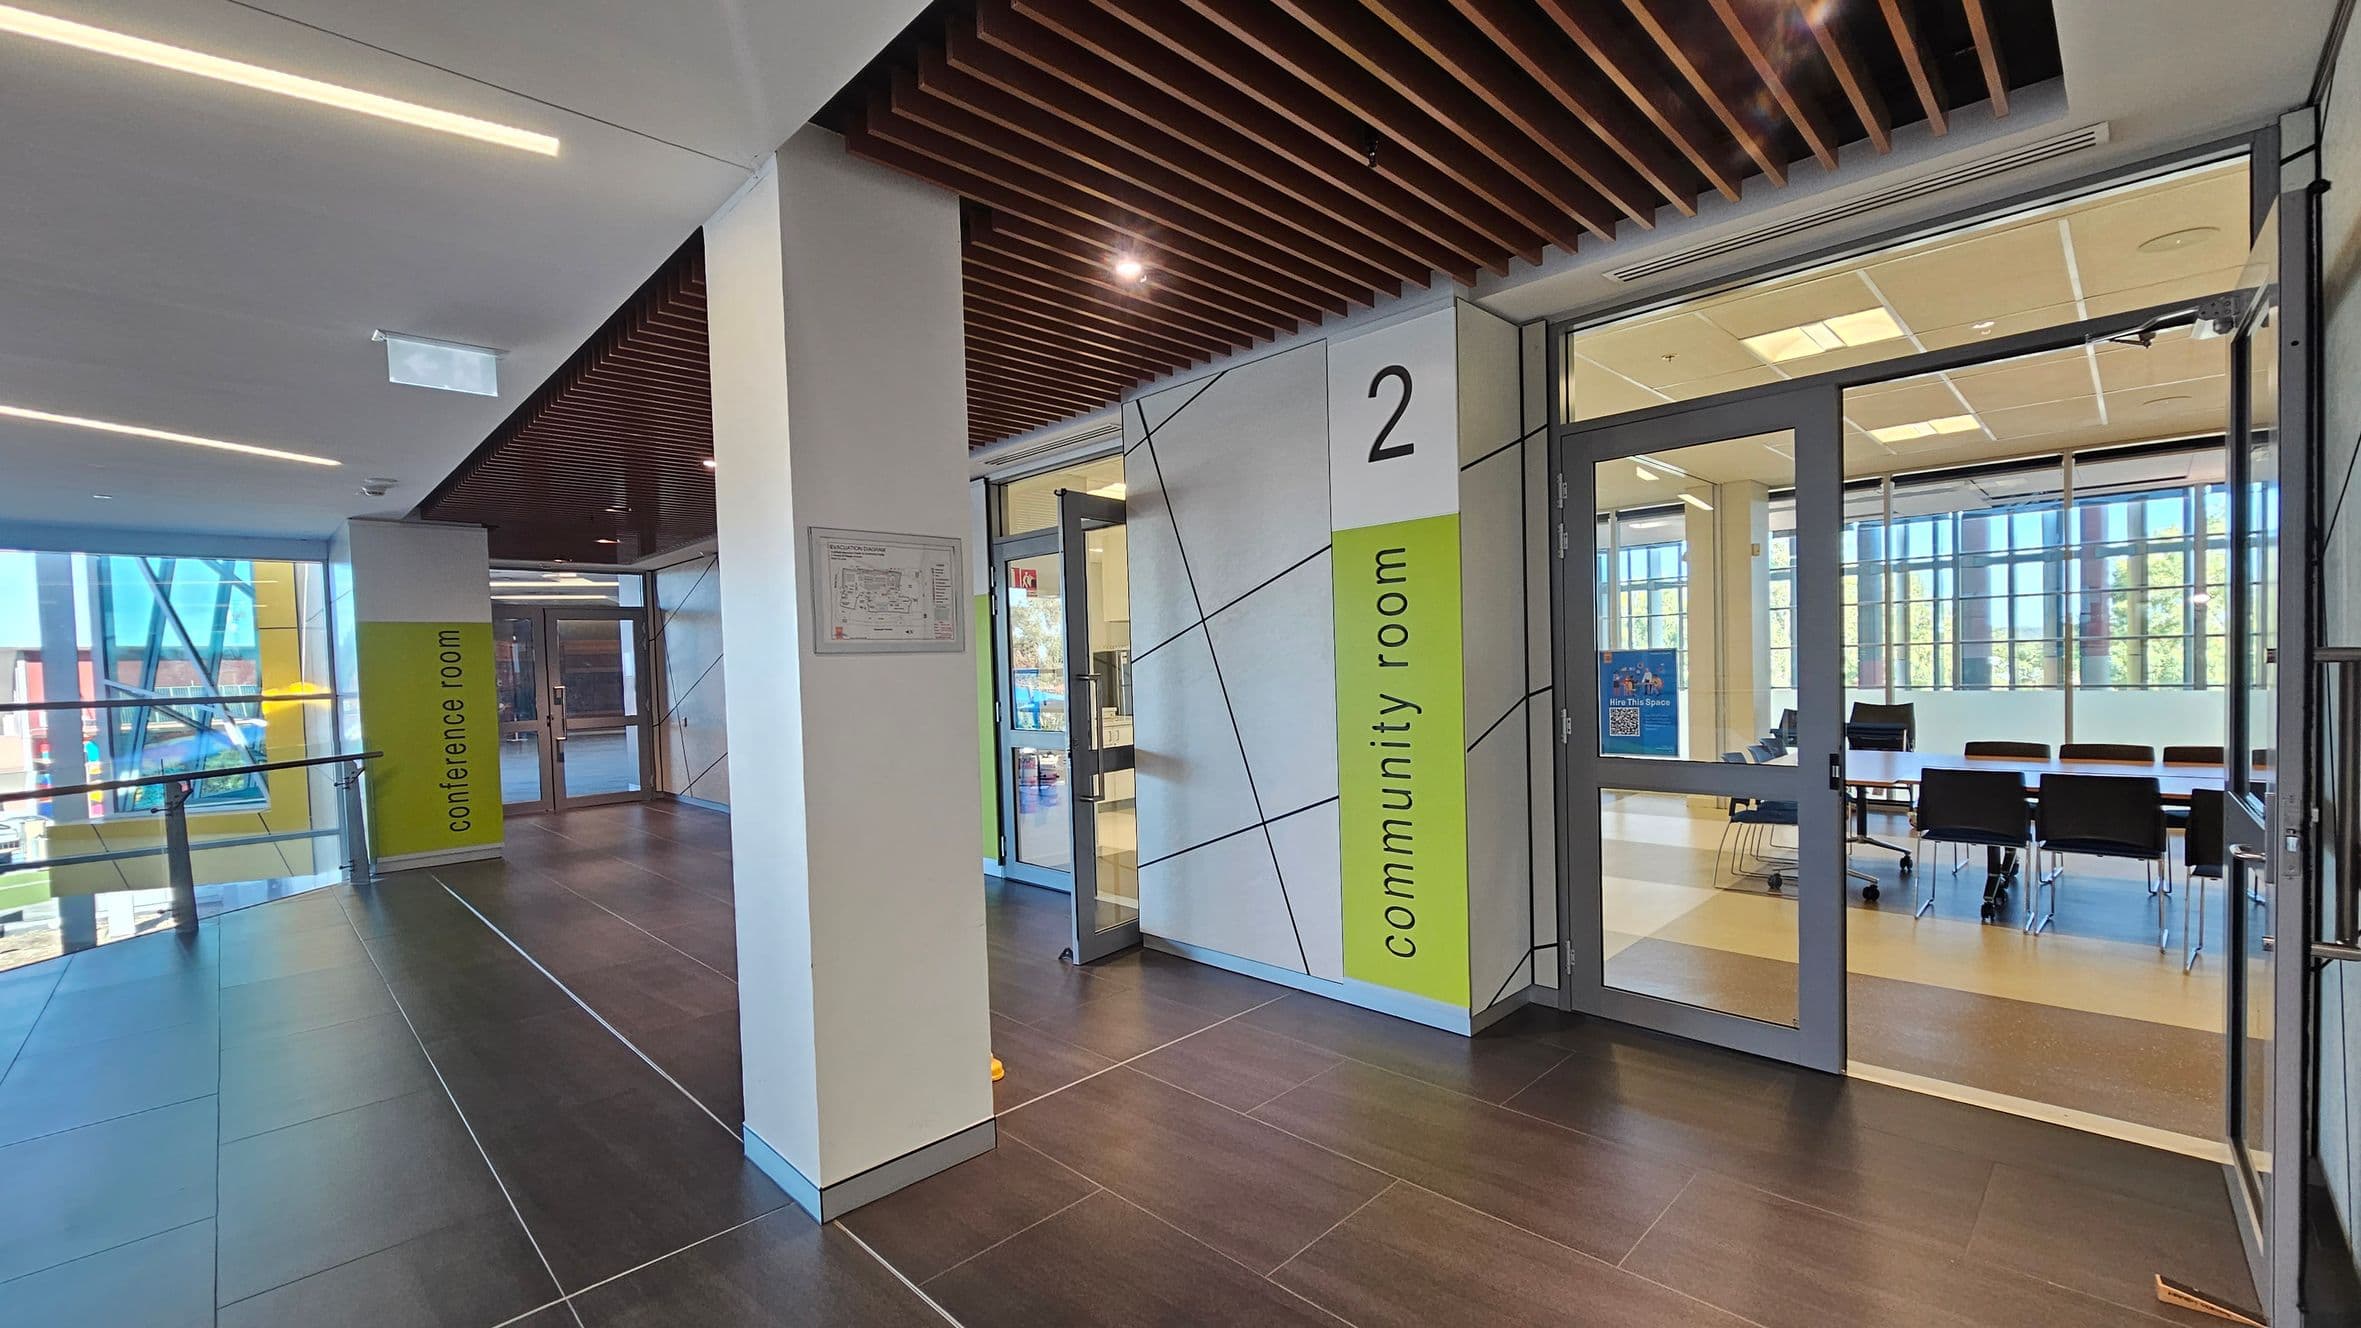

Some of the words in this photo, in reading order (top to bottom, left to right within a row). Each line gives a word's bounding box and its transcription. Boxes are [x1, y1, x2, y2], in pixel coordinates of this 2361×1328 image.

[1367, 364, 1415, 464] 2
[438, 629, 463, 688] room
[1375, 547, 1409, 668] room
[1609, 698, 1626, 706] Hire
[1627, 698, 1644, 706] This
[1645, 699, 1671, 708] Space
[438, 699, 472, 832] conference
[1369, 693, 1423, 959] community
